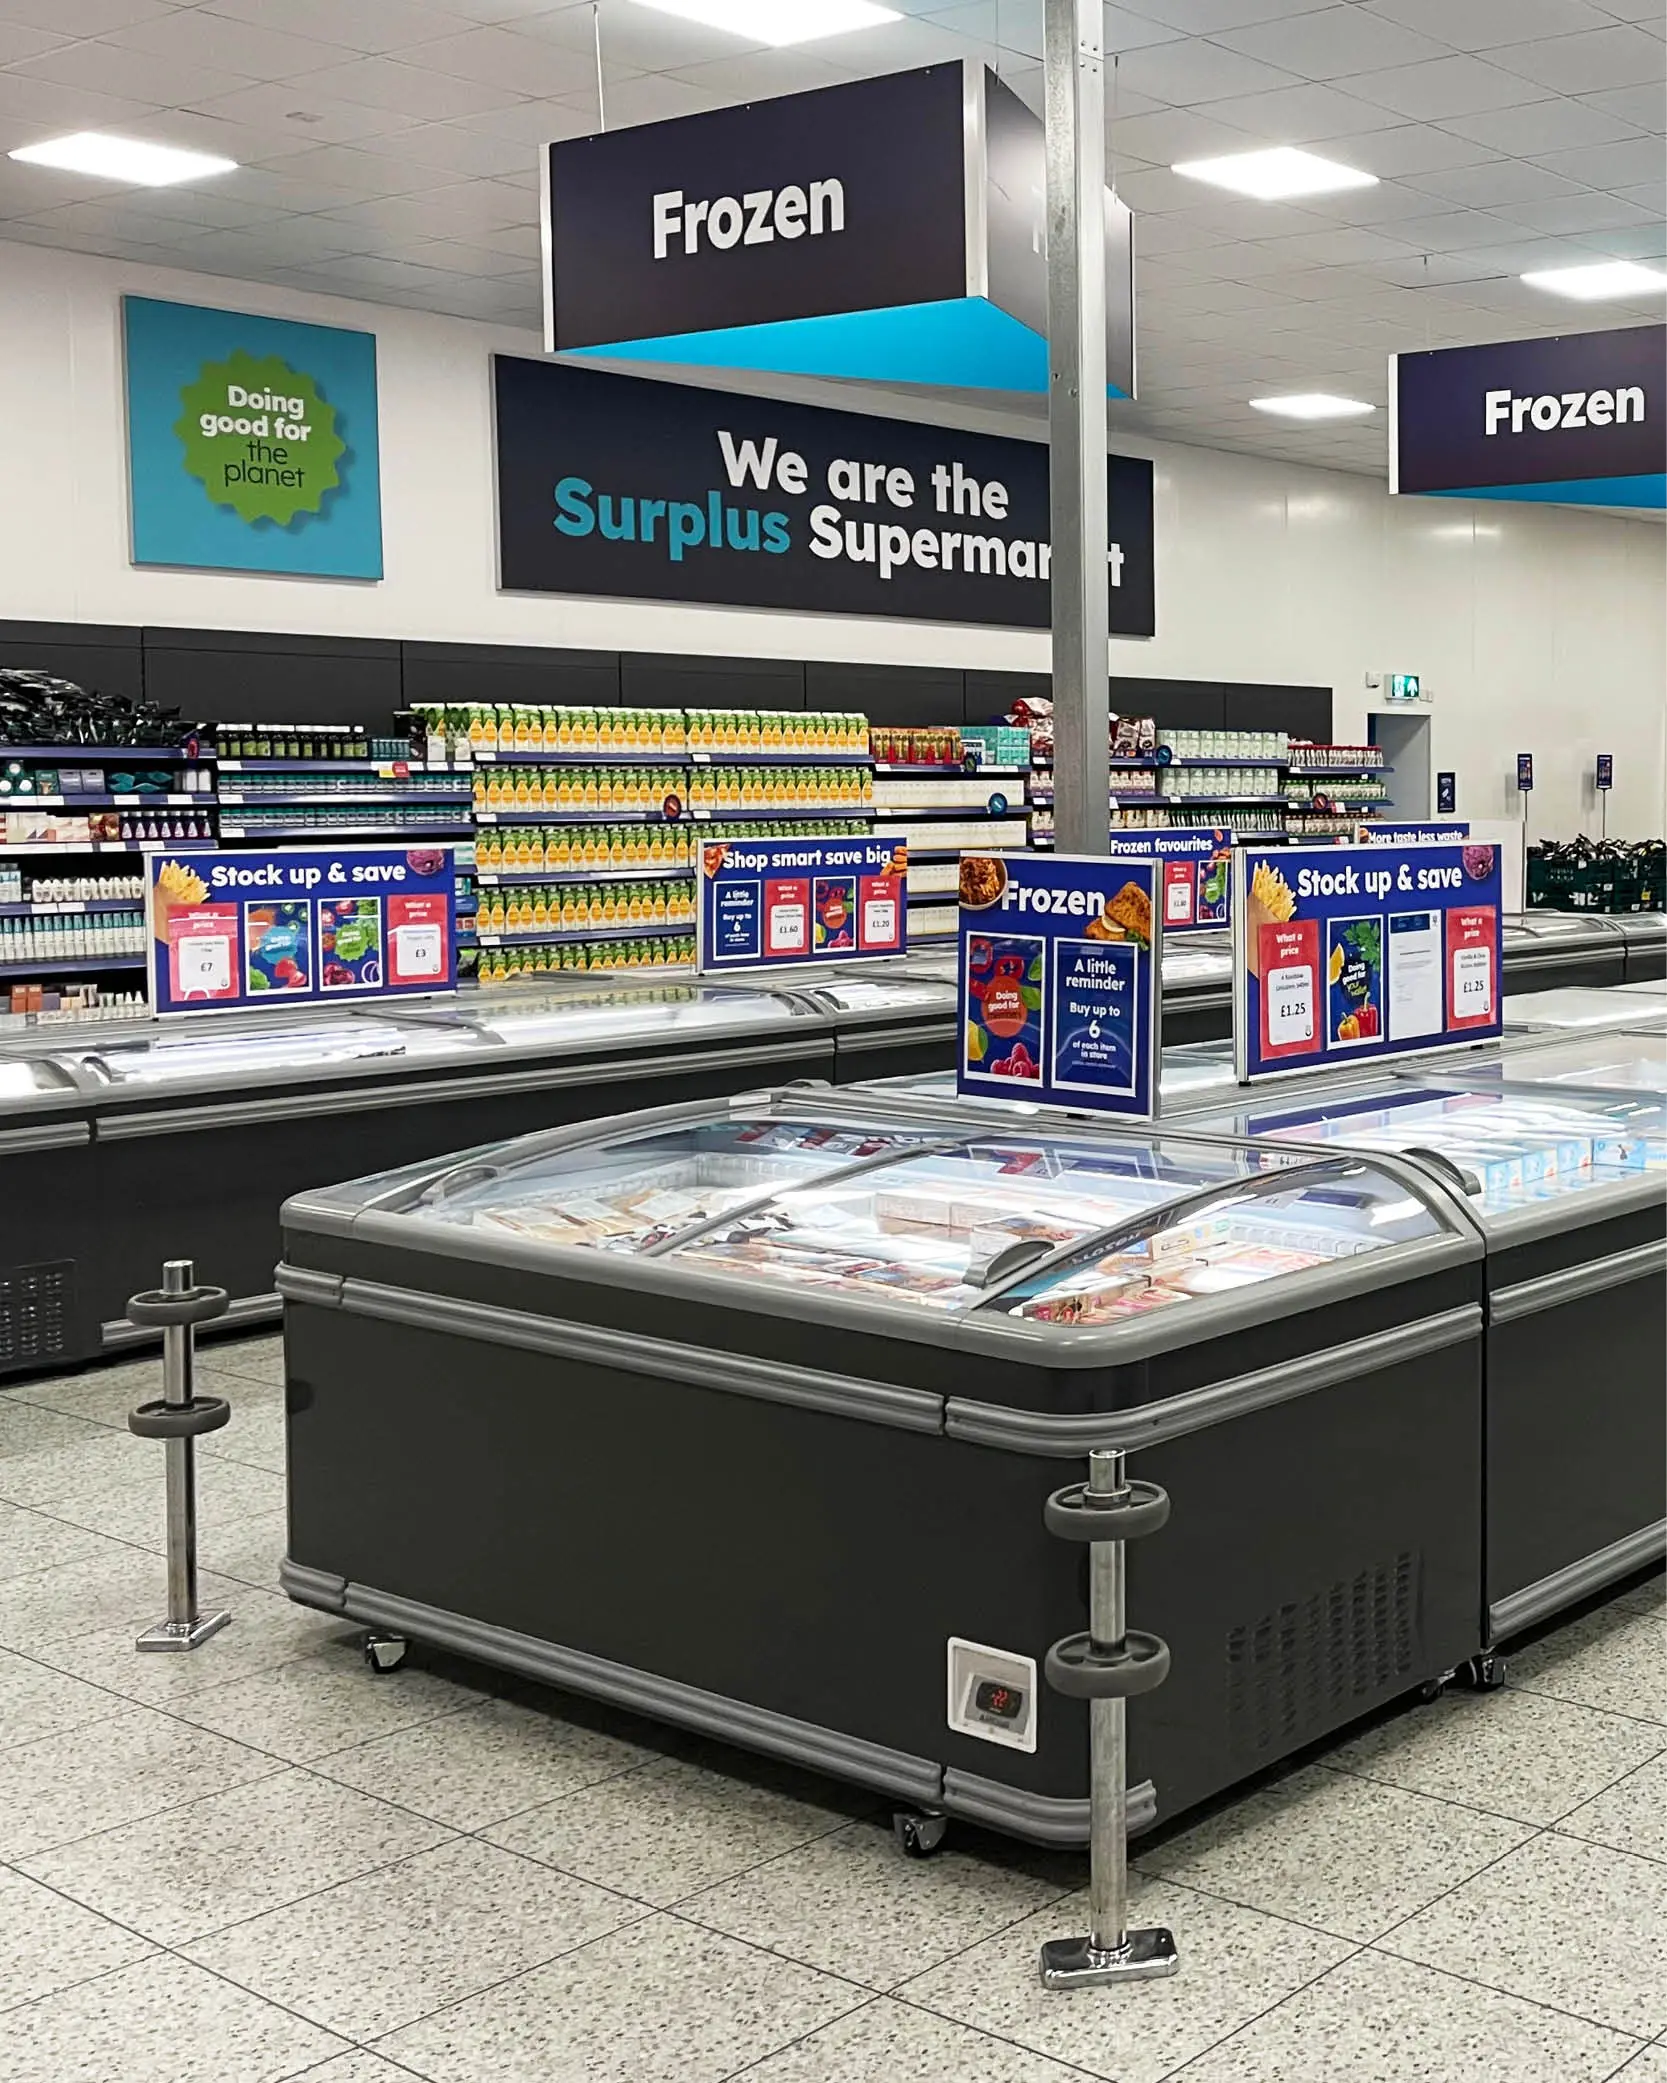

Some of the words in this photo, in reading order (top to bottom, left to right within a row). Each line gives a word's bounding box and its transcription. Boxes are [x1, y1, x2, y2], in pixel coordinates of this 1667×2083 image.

[653, 178, 845, 259] Frozen
[228, 384, 304, 420] Doing
[1485, 386, 1646, 437] Frozen
[199, 413, 269, 438] good
[273, 415, 312, 442] for
[246, 439, 288, 466] the
[224, 460, 305, 489] planet
[717, 430, 808, 495] We
[828, 458, 915, 507] are
[931, 462, 1009, 520] the
[553, 476, 791, 561] Surplus
[809, 505, 1124, 587] Supermart
[1110, 839, 1152, 854] Frozen
[1154, 835, 1213, 852] favourites
[1368, 832, 1392, 844] More
[1394, 831, 1417, 843] taste
[1418, 831, 1436, 842] less
[1437, 830, 1463, 841] waste
[722, 850, 768, 872] Shop
[771, 849, 822, 867] smart
[825, 851, 862, 865] save
[866, 844, 891, 867] big
[211, 864, 283, 887] Stock
[289, 867, 322, 889] up
[327, 862, 347, 883] &
[351, 864, 406, 882] save
[1297, 865, 1360, 897] Stock
[1365, 871, 1392, 900] up
[1397, 863, 1414, 891] &
[1417, 867, 1463, 890] save
[1002, 880, 1106, 916] Frozen
[1275, 933, 1296, 944] What
[1280, 945, 1299, 959] price
[1074, 958, 1085, 973] A
[1087, 958, 1117, 975] little
[1066, 974, 1126, 991] reminder
[1463, 980, 1484, 993] £1.25
[996, 990, 1018, 1001] Doing
[988, 1001, 1008, 1012] good
[1008, 1000, 1020, 1009] for
[1069, 1002, 1091, 1018] Buy
[1092, 1005, 1107, 1019] up
[1108, 1005, 1121, 1017] to
[1280, 1002, 1306, 1018] £1.25
[1088, 1019, 1101, 1039] 6
[1072, 1041, 1081, 1049] of
